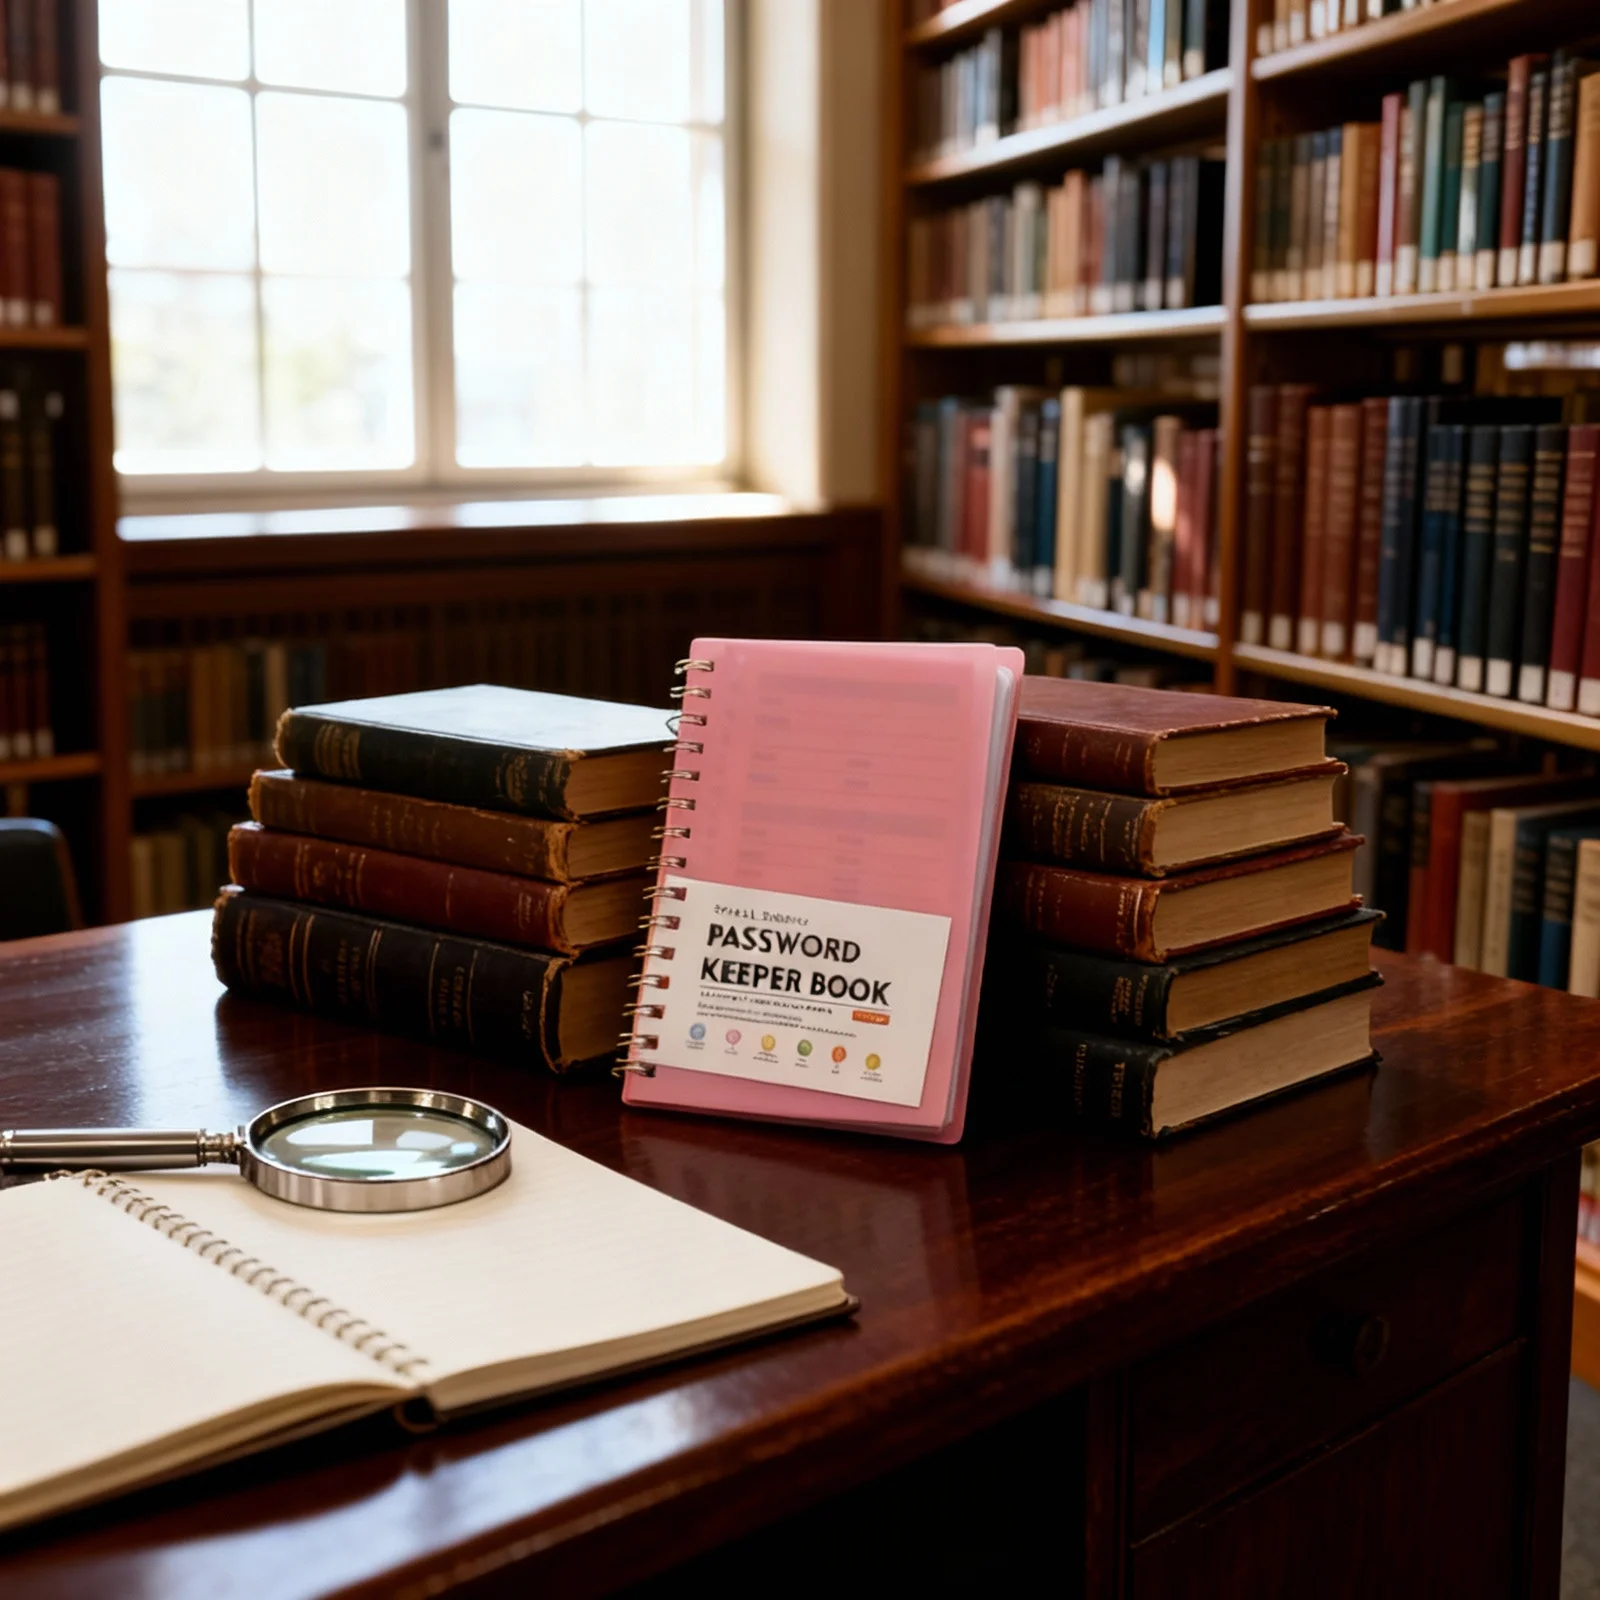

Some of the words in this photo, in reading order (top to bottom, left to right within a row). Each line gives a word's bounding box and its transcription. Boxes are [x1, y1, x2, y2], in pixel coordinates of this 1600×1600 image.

[707, 924, 861, 963] PASSWORD
[701, 957, 802, 993] KEEPER
[811, 972, 891, 1005] BOOK
